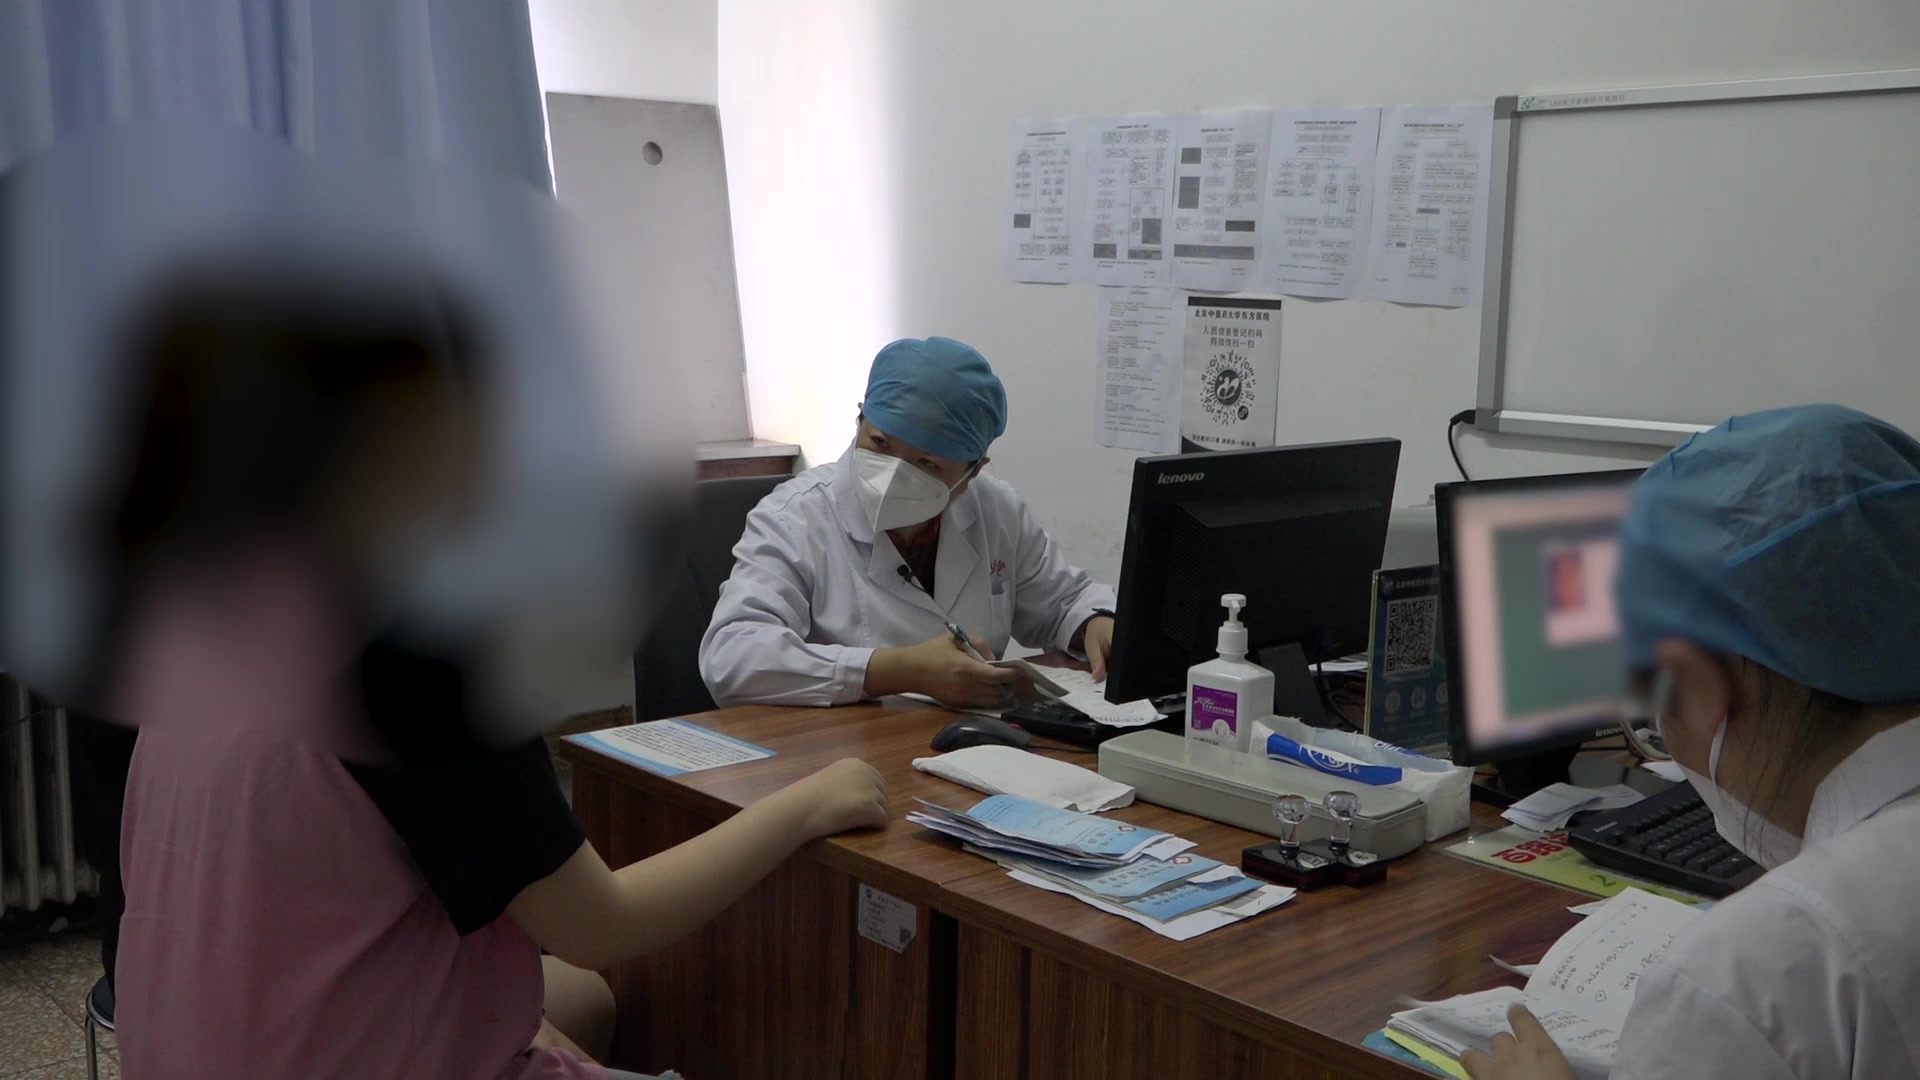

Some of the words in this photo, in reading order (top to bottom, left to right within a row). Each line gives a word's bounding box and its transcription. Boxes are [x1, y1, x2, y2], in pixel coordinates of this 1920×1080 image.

[1194, 309, 1270, 321] 北京中医药大学东方医院
[1157, 472, 1205, 484] lenovo
